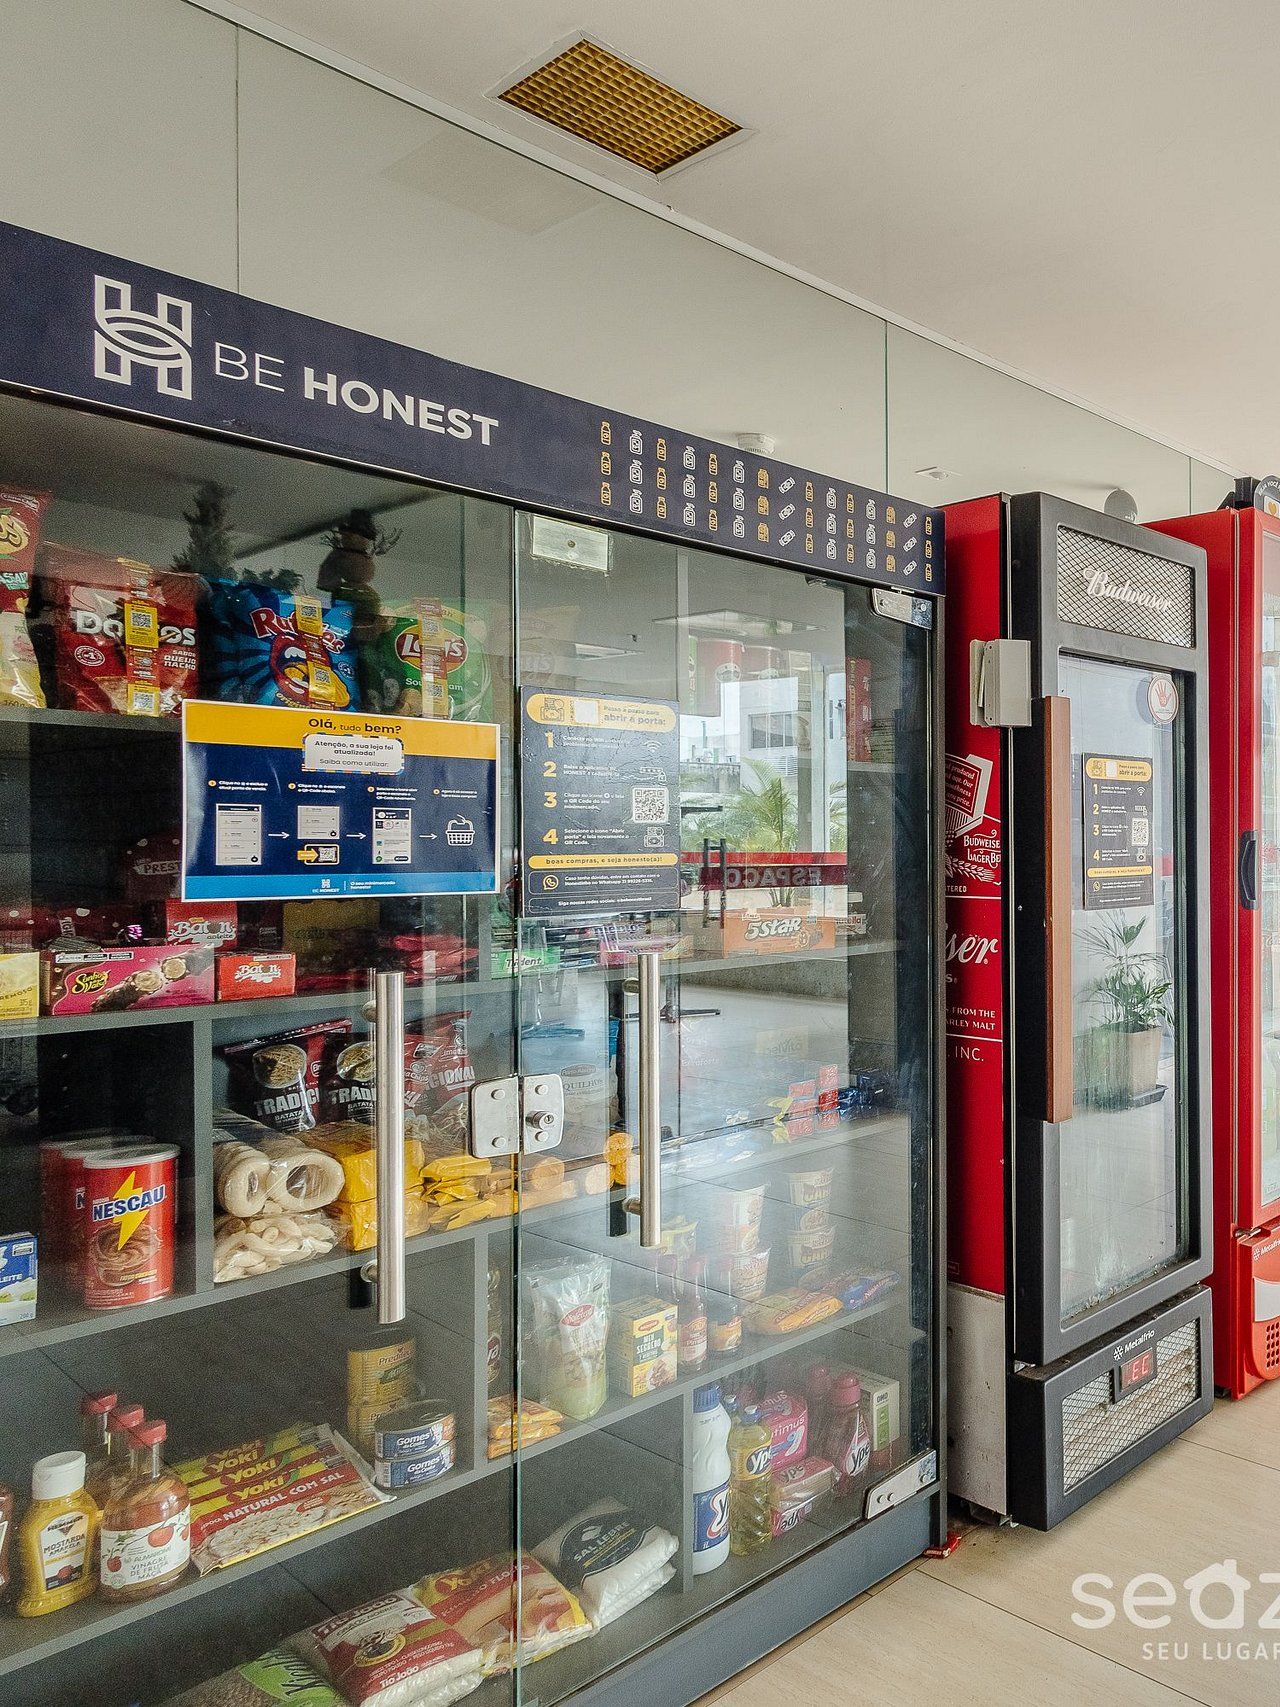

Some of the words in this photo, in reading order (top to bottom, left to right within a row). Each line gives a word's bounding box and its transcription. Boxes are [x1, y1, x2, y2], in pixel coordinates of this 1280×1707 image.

[214, 342, 285, 392] BE
[304, 366, 499, 446] HONEST
[1082, 567, 1171, 613] Budweiser
[163, 660, 196, 670] NACHO
[164, 655, 197, 664] QUEIJO
[308, 718, 337, 730] Olá,
[364, 723, 402, 734] bem?
[603, 713, 628, 722] abrir
[637, 716, 666, 725] porta:
[314, 740, 348, 749] Atenção,
[544, 730, 554, 749] 1
[333, 749, 376, 757] atualizada!
[543, 760, 557, 778] 2
[962, 778, 974, 789] Our
[1092, 783, 1098, 795] 1
[543, 791, 558, 808] 3
[1092, 803, 1100, 815] 2
[542, 828, 559, 845] 4
[1092, 824, 1100, 836] 3
[963, 834, 1001, 849] BUDWEISE
[1092, 850, 1100, 861] 4
[506, 957, 542, 968] Trident
[0, 986, 33, 1000] REMOSO
[952, 1006, 977, 1016] FROM
[978, 1009, 996, 1018] THE
[972, 1021, 996, 1030] MALT
[955, 1045, 984, 1061] INC.
[92, 1184, 166, 1222] NESCAU
[1124, 1330, 1155, 1354] Metalfrio
[397, 1432, 431, 1446] Gomes
[407, 1457, 440, 1473] Gomes
[222, 1492, 288, 1521] NATURAL
[289, 1480, 319, 1496] COM
[320, 1472, 344, 1485] SAL
[43, 1533, 86, 1554] MOSTARDA
[573, 1546, 597, 1563] SAL
[596, 1521, 630, 1546] LEBRE
